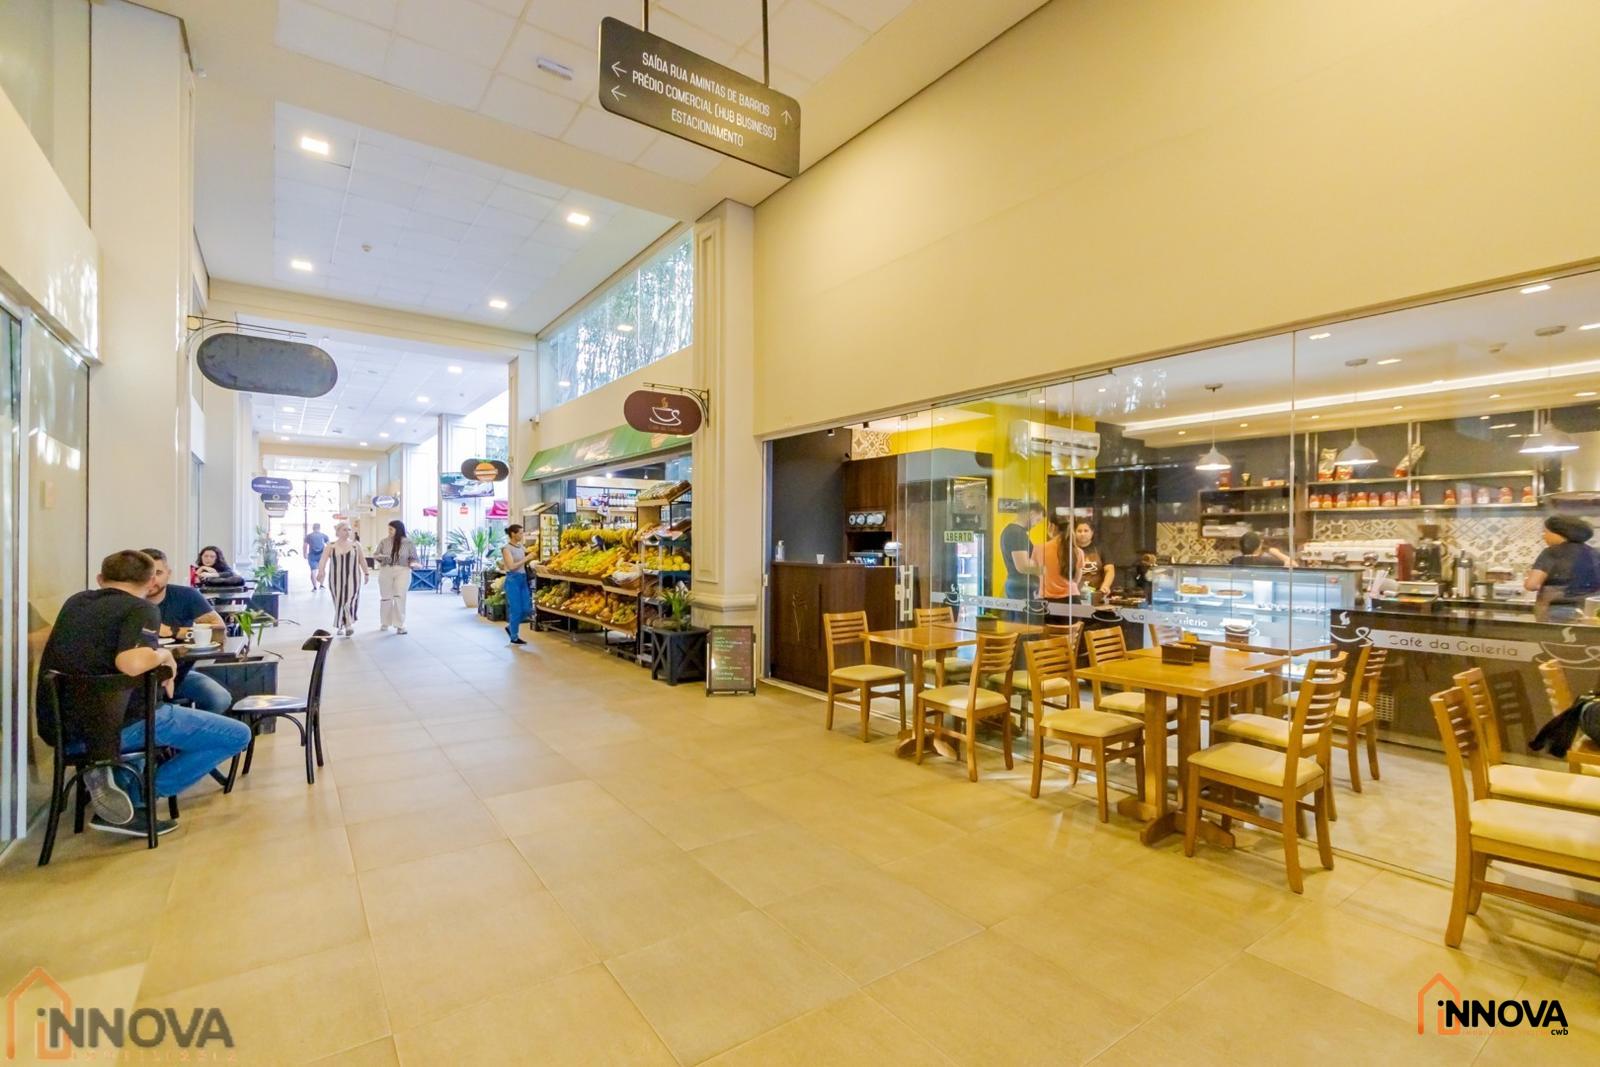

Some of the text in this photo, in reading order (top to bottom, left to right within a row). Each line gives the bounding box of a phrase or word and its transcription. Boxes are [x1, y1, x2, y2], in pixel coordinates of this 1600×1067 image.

[632, 70, 664, 95] PRÉDIO
[665, 84, 713, 114] COMERCIAL
[642, 52, 770, 117] SAÍDA RUA AMINTAS DE BARROS
[671, 108, 744, 147] ESTACIONAMENTO
[945, 532, 972, 542] ABERTO
[1388, 634, 1518, 657] Café da Galeria
